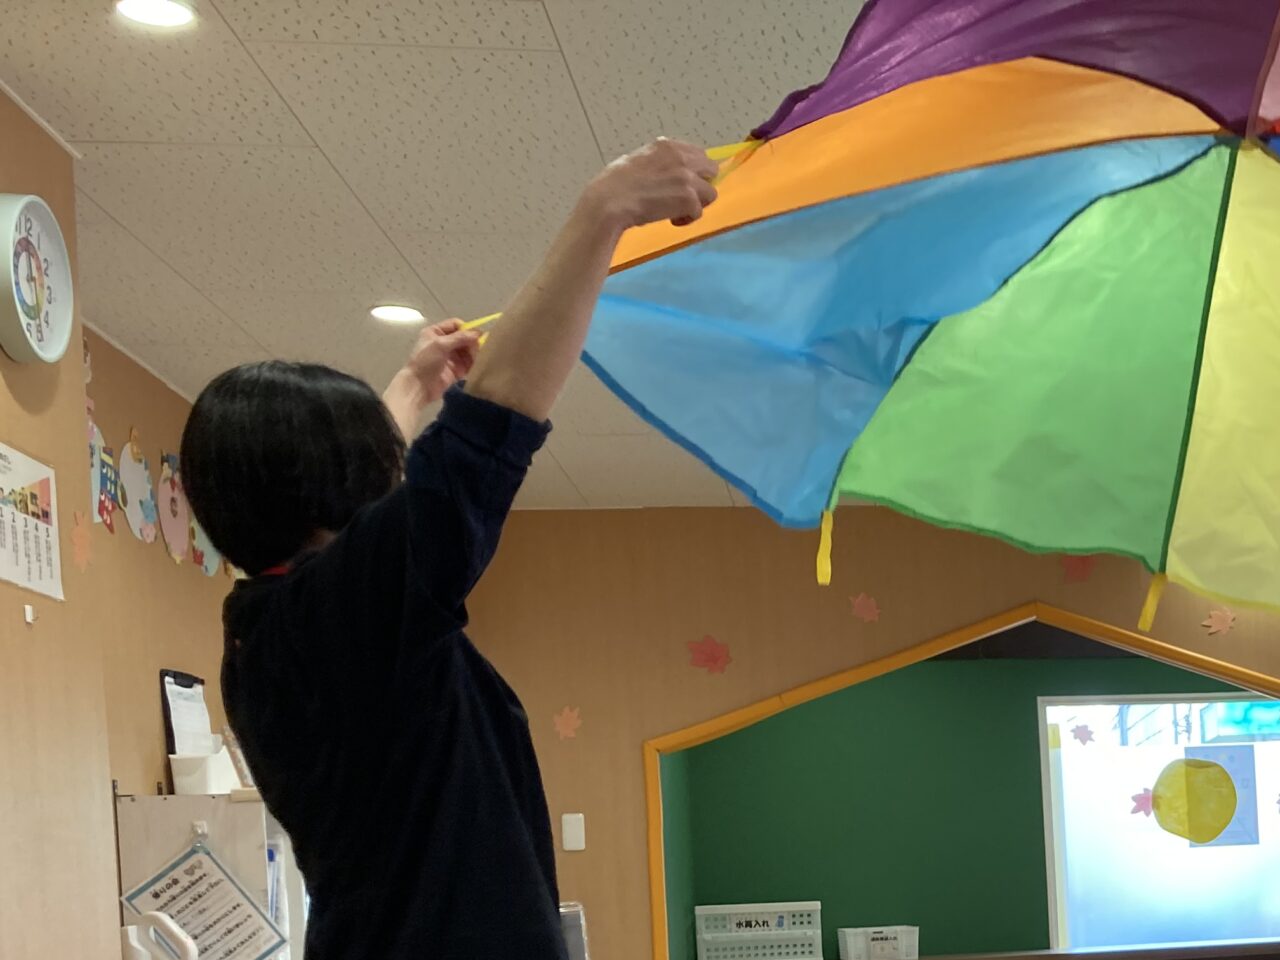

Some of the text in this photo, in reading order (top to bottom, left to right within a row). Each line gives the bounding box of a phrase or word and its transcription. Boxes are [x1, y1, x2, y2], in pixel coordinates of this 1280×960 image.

[24, 216, 33, 237] 12
[43, 258, 49, 277] 2
[46, 286, 52, 305] 3
[43, 310, 49, 329] 4
[735, 920, 770, 929] 水筒入れ
